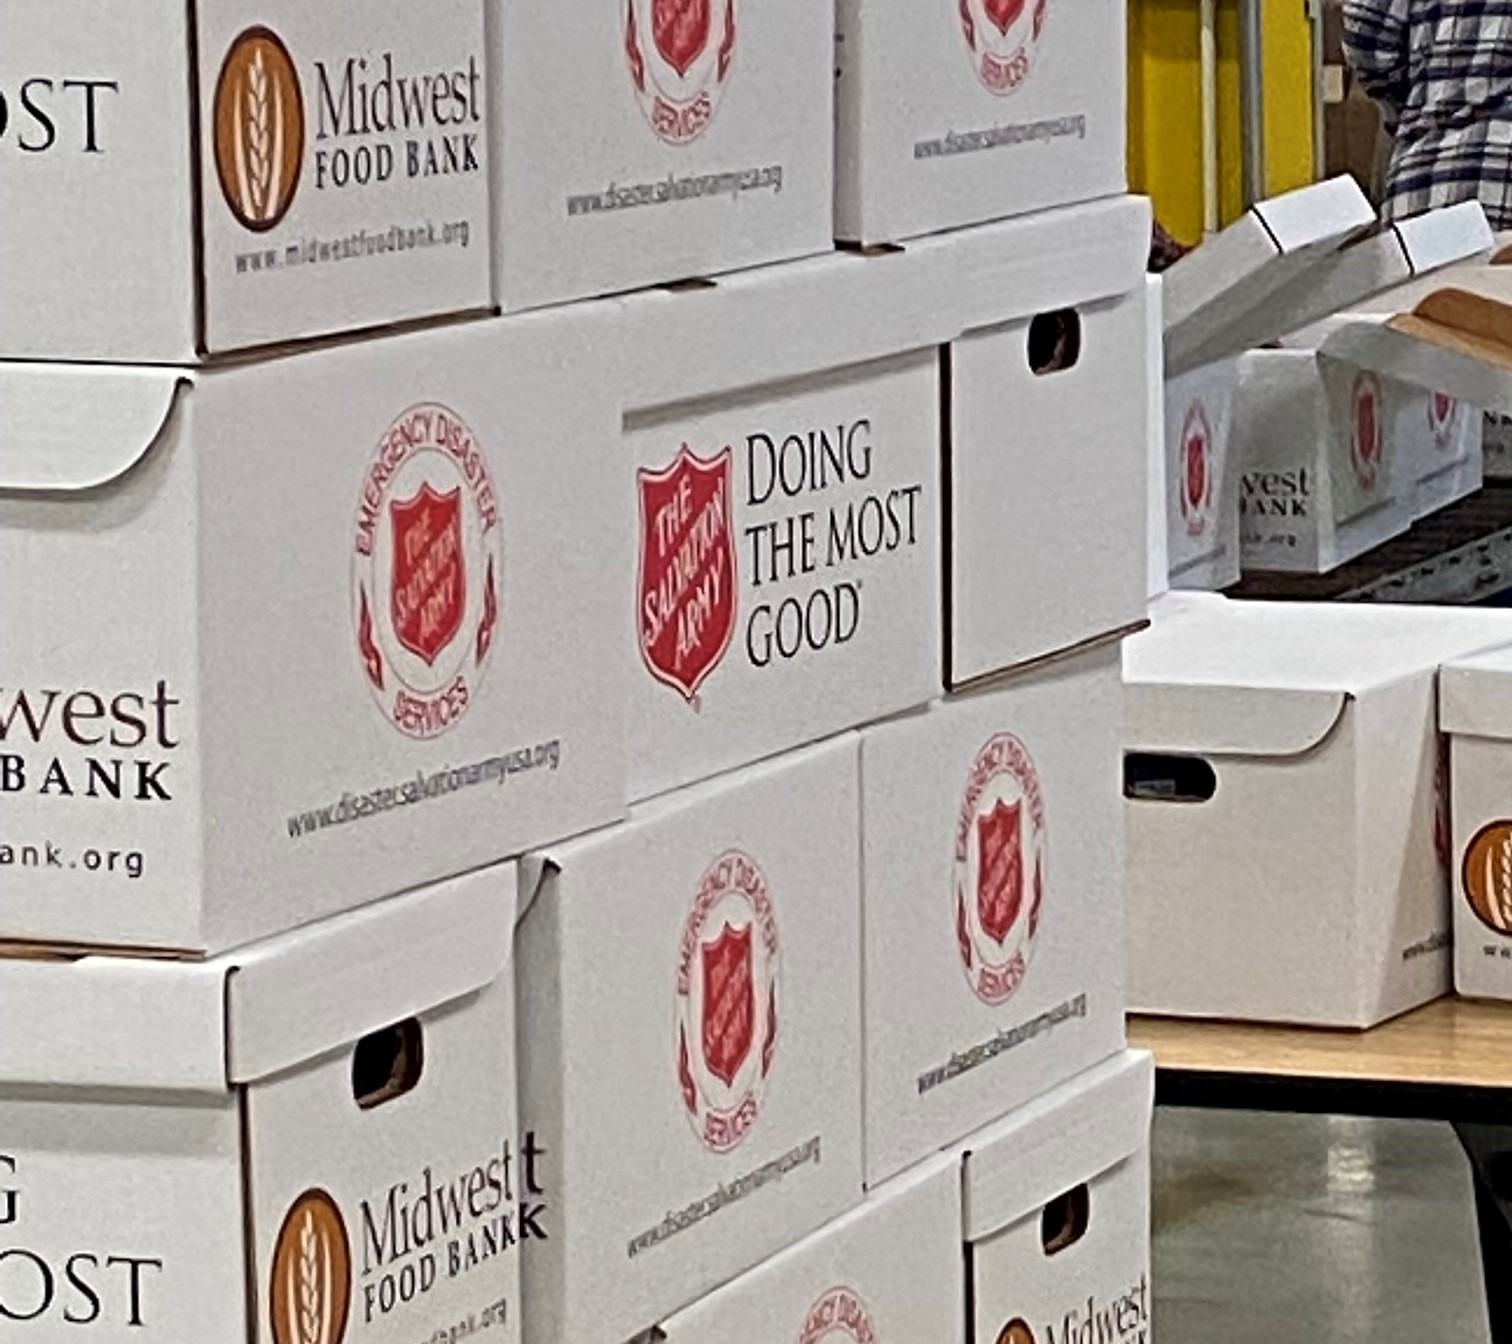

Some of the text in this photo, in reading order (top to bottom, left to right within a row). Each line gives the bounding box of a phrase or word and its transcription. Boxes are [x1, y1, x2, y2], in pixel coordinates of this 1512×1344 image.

[0, 78, 119, 153] ST
[314, 52, 480, 140] Midwest
[315, 133, 479, 190] FOOD BANK
[746, 419, 872, 506] DOING
[655, 474, 692, 557] THE
[745, 485, 922, 587] THE MOST
[643, 476, 725, 647] SALVATION
[674, 547, 724, 671] ARMY
[746, 582, 860, 667] GOOD
[0, 753, 172, 800] BANK
[361, 1138, 513, 1276] Midwest
[363, 1254, 437, 1323] FOOD
[448, 1211, 516, 1278] BANK
